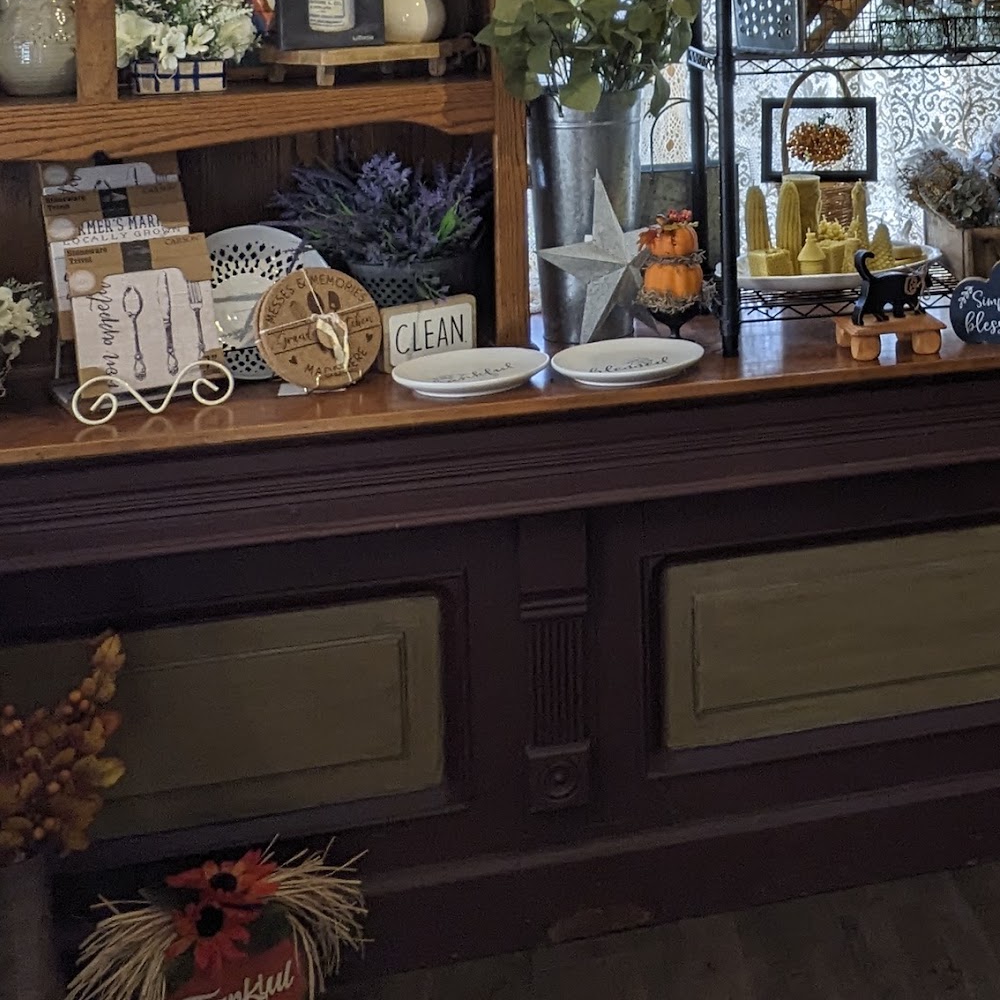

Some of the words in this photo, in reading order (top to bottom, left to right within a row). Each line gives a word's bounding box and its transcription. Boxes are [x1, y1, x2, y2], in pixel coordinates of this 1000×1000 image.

[78, 217, 124, 236] RMER'S
[128, 214, 163, 231] MAR
[63, 232, 128, 246] LOCALLY
[310, 273, 366, 302] MEMORIES
